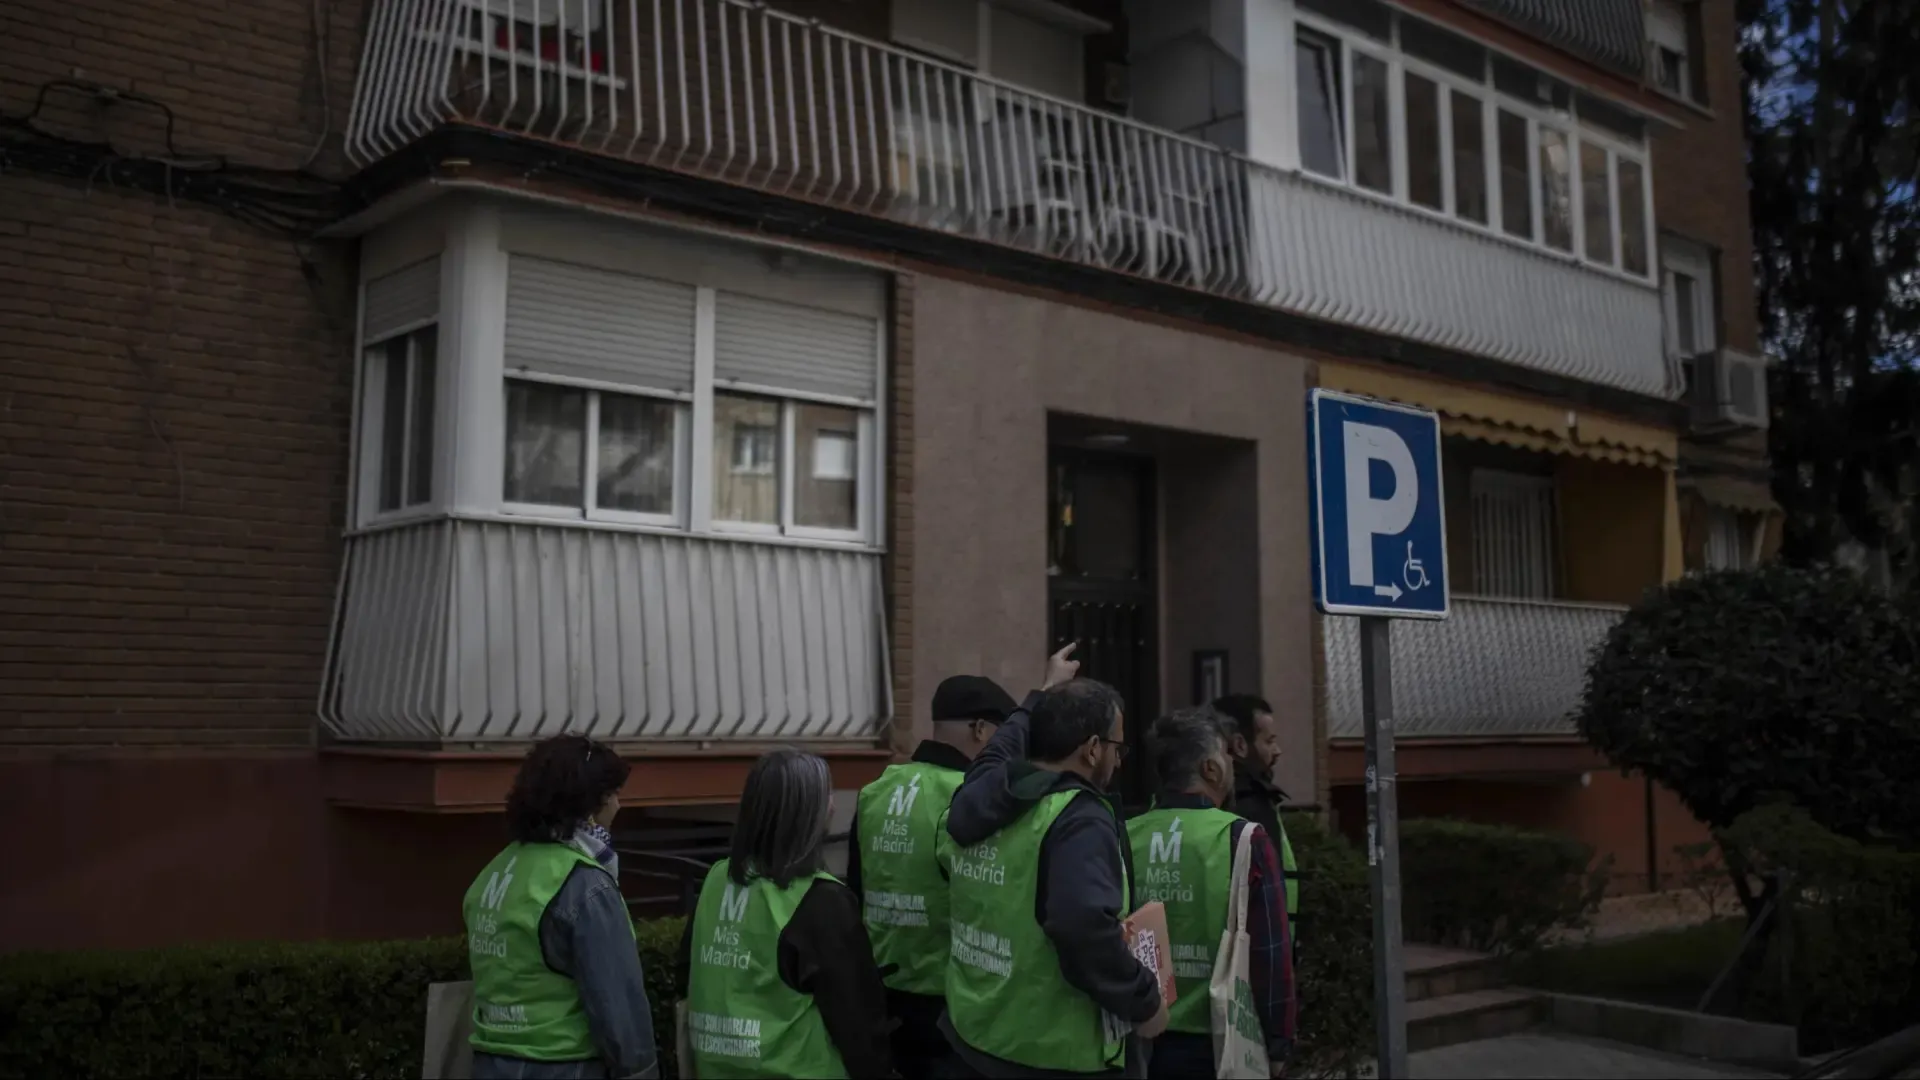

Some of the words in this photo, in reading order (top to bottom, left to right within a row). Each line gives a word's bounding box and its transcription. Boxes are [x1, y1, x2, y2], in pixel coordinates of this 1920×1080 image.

[1343, 420, 1419, 587] P
[872, 836, 914, 854] Madrid
[950, 854, 1005, 886] Madrid
[1145, 866, 1181, 884] Más
[1136, 884, 1193, 903] Madrid
[475, 913, 497, 934] Más
[713, 925, 740, 945] Más
[701, 945, 751, 970] Madrid
